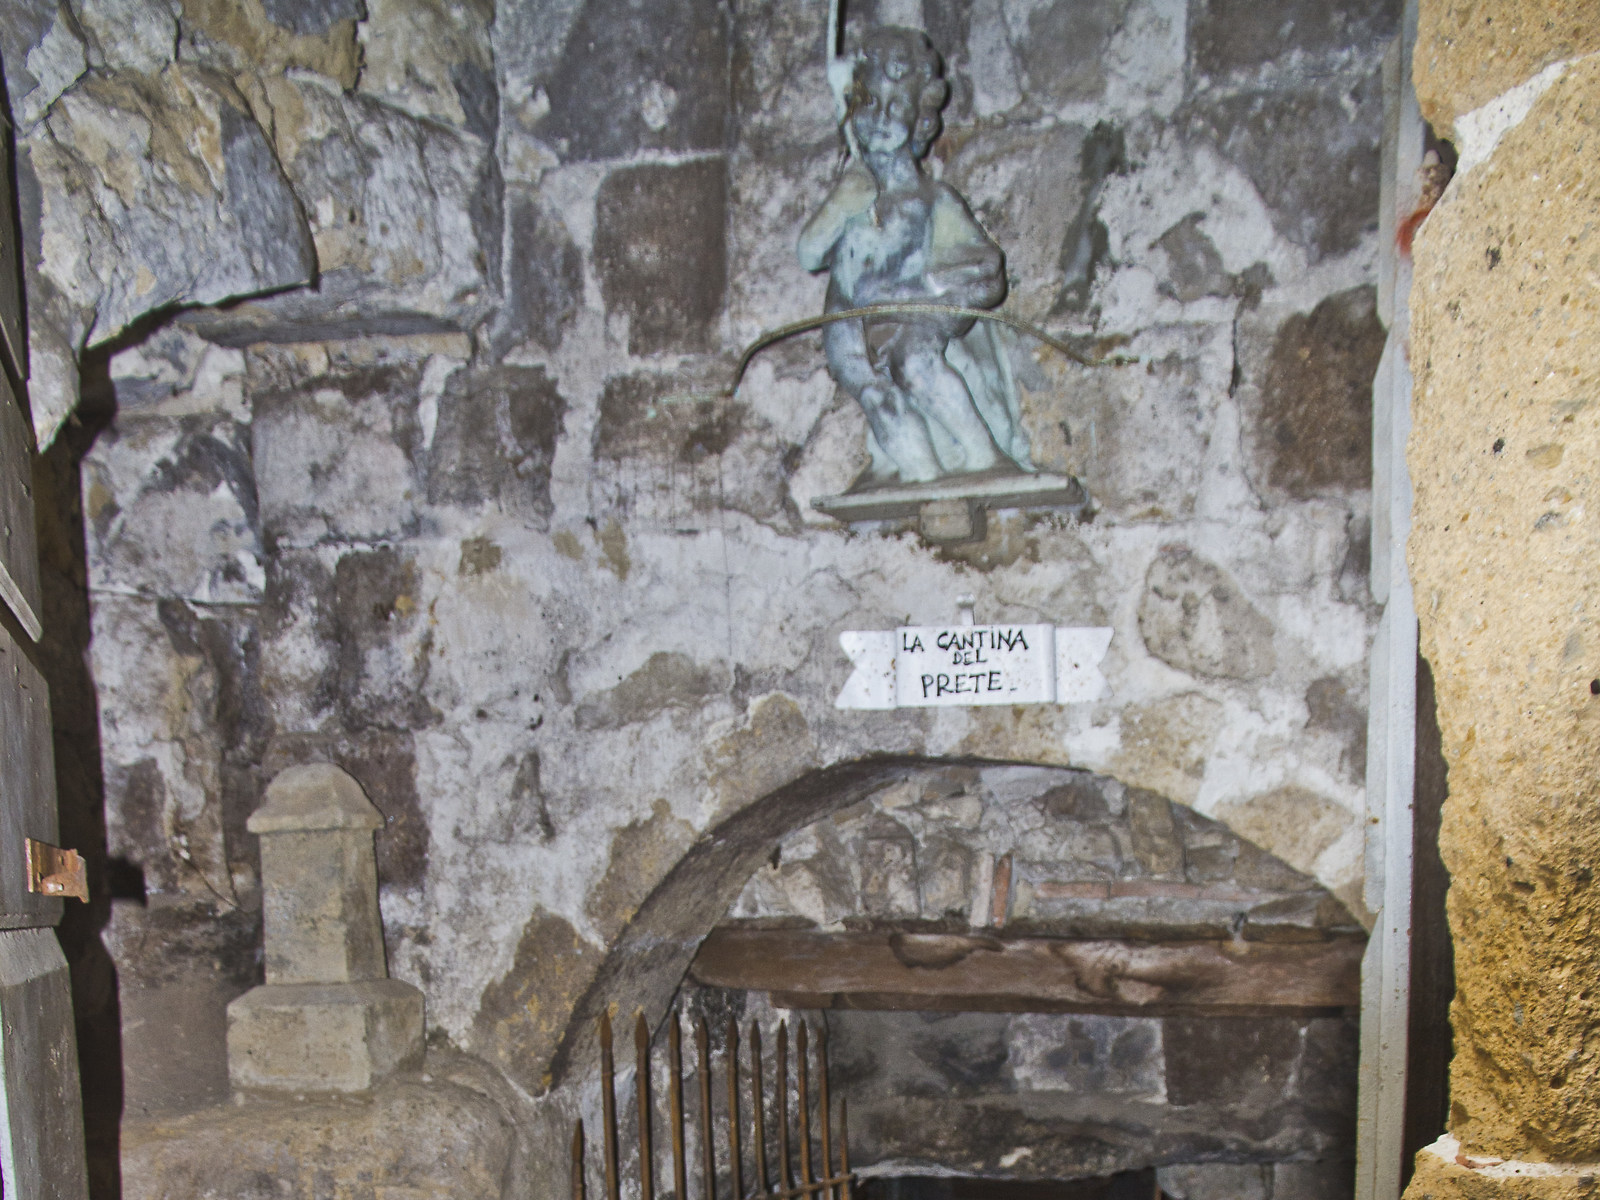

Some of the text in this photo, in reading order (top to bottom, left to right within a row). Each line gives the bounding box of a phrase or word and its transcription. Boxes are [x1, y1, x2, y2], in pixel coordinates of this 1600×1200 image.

[903, 632, 924, 653] LA
[952, 648, 988, 666] DEL
[921, 670, 1002, 698] PRETE
